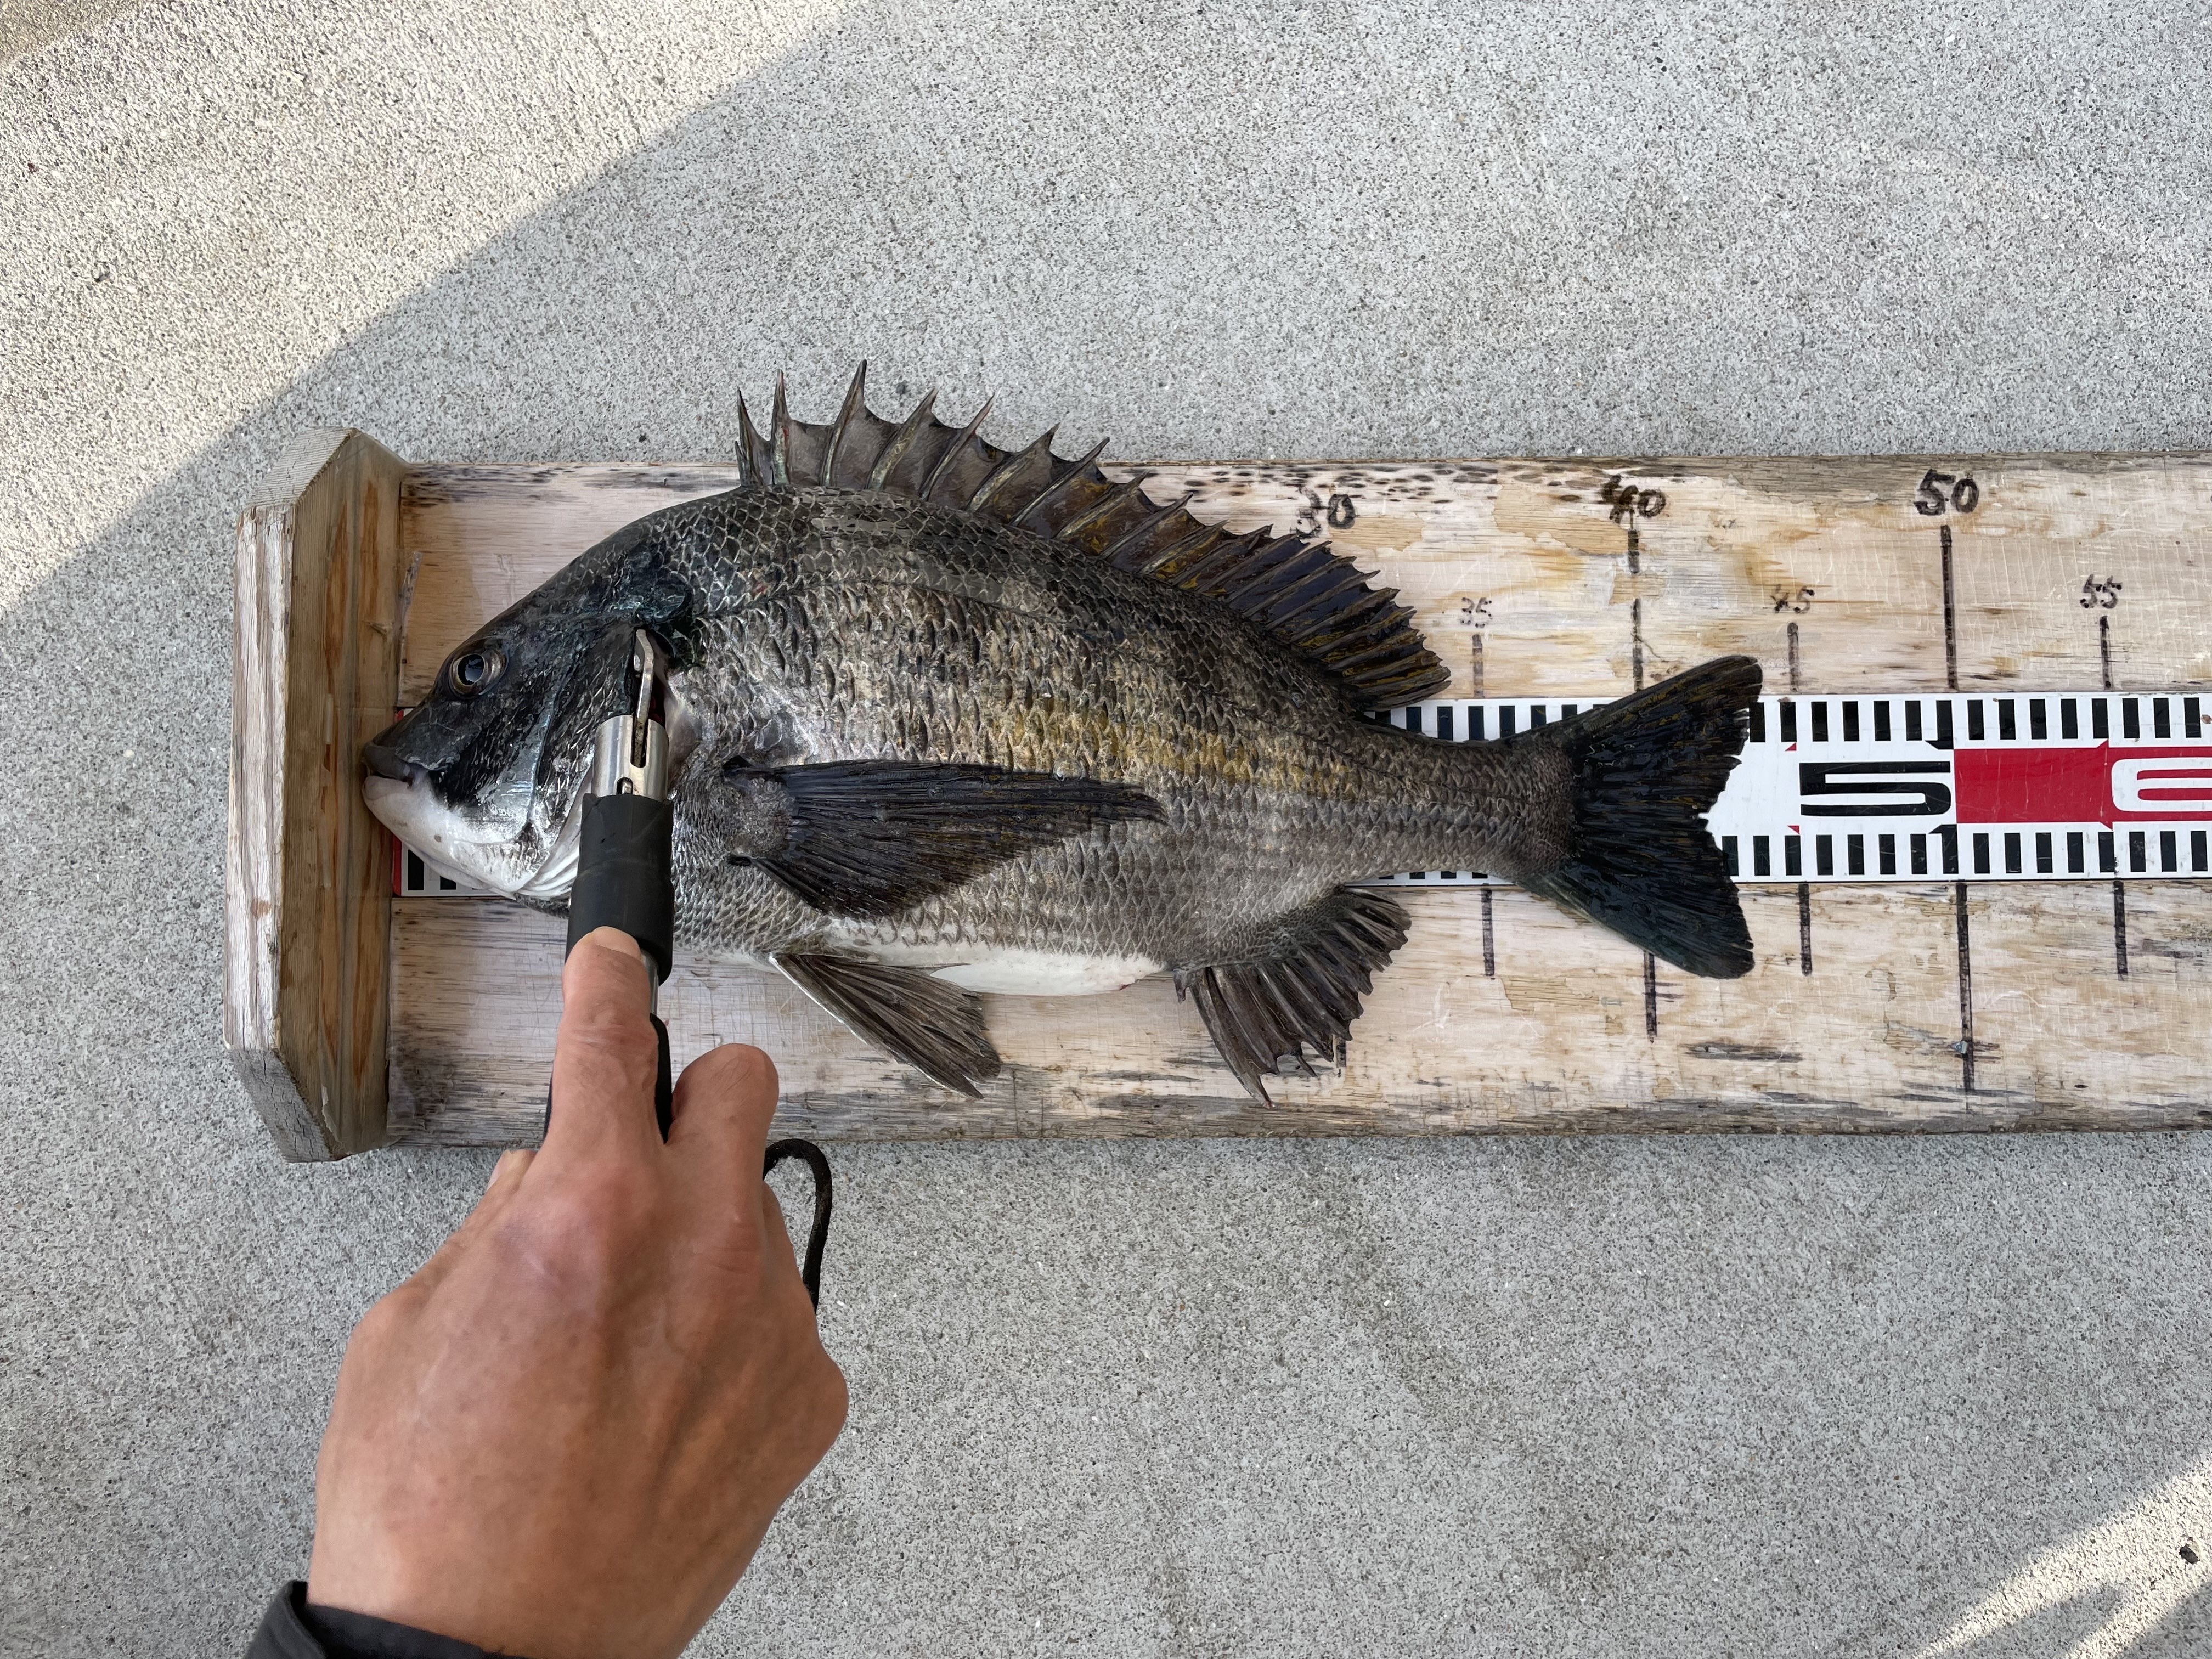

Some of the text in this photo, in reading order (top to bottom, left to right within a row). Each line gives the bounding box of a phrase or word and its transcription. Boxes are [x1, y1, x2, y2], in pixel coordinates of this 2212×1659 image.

[1295, 486, 1356, 539] 30
[1914, 469, 1979, 516] 50
[1459, 596, 1493, 628] 35
[1770, 584, 1815, 614] 45
[2080, 574, 2123, 609] 55
[1799, 760, 1951, 817] 5
